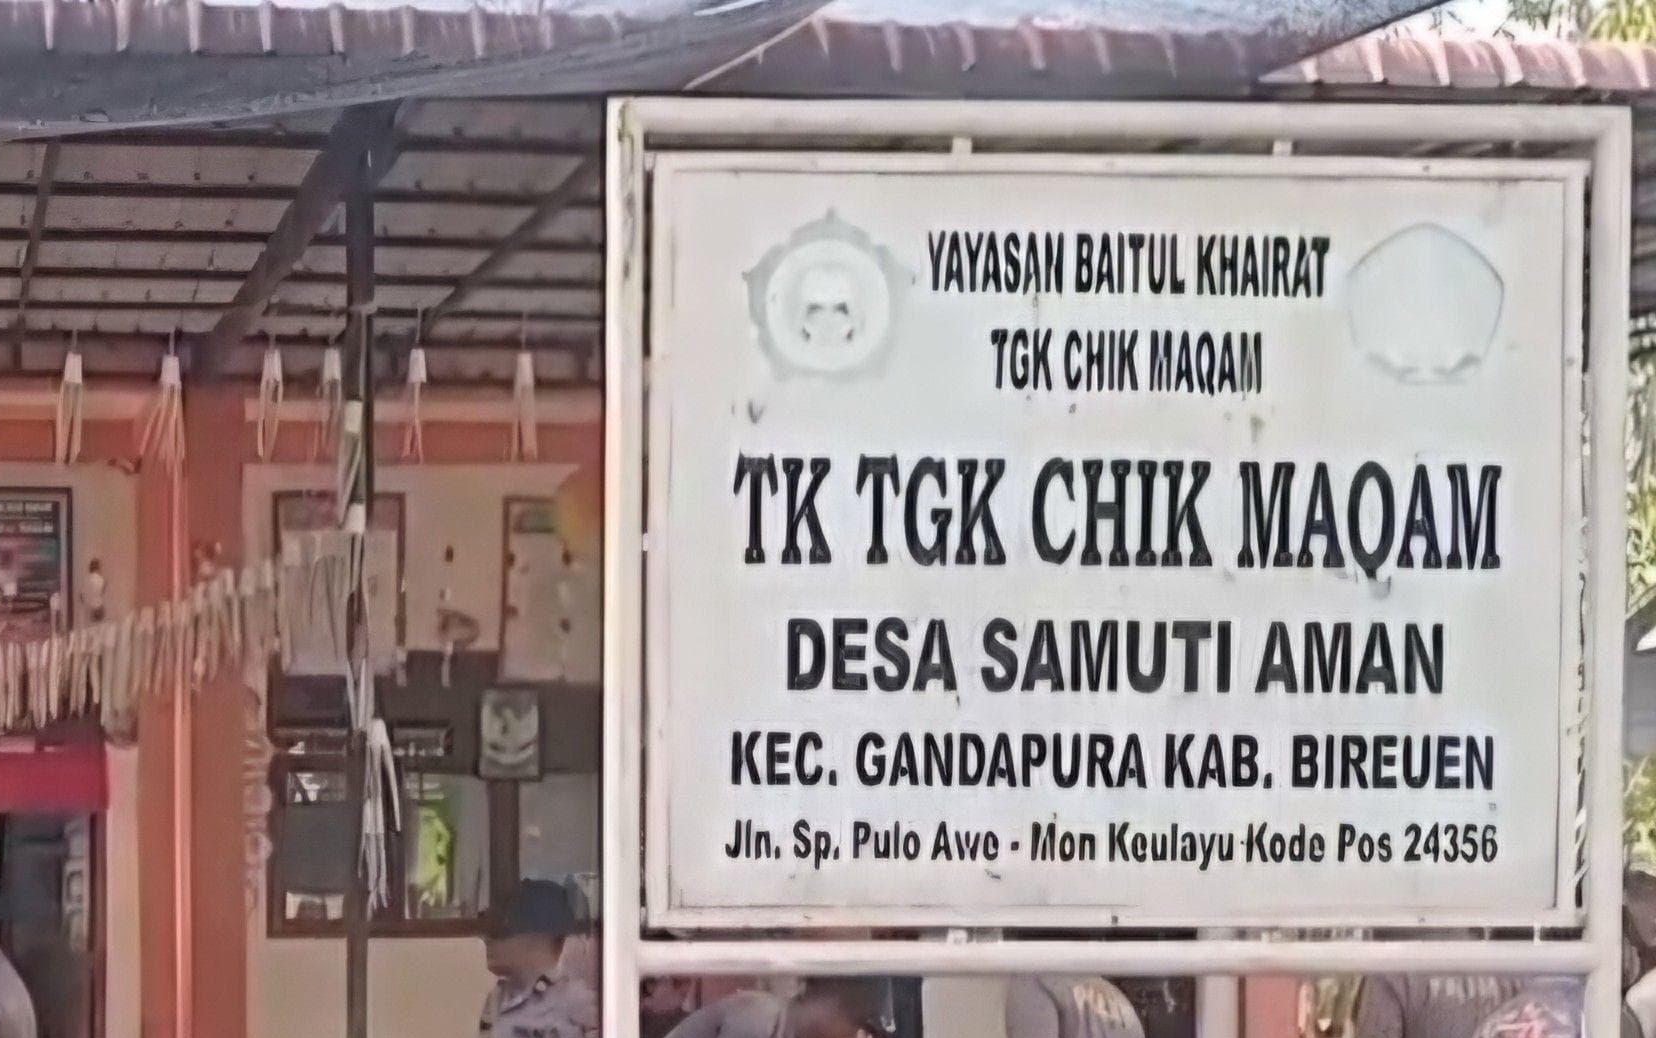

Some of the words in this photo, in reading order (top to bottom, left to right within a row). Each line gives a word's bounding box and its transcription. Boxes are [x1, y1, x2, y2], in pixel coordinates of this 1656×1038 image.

[928, 230, 1064, 295] YAYASAN
[1075, 232, 1186, 295] BAITUL
[1196, 234, 1331, 298] KHAIRAT
[990, 328, 1053, 392] TGK
[1063, 329, 1139, 392] CHIK
[1149, 330, 1263, 396] MAQAM
[733, 453, 832, 565] TK
[855, 454, 1007, 567] TGK
[1031, 457, 1213, 567] CHIK
[1237, 461, 1502, 577] MAQAM
[787, 617, 958, 692] DESA
[980, 617, 1232, 694] SAMUTI
[1254, 621, 1444, 695] AMAN
[731, 731, 838, 788] KEC.
[855, 731, 1147, 790] GANDAPURA
[1164, 733, 1273, 789] KAB.
[1291, 734, 1494, 791] BIREUEN
[725, 819, 781, 860] Jln.
[792, 819, 840, 870] Sp.
[852, 820, 921, 861] Pulo
[1030, 821, 1096, 862] Mon
[1108, 821, 1234, 871] Keulayu
[1245, 822, 1325, 863] Kode
[1337, 823, 1393, 863] Pos
[1403, 822, 1498, 864] 24356
